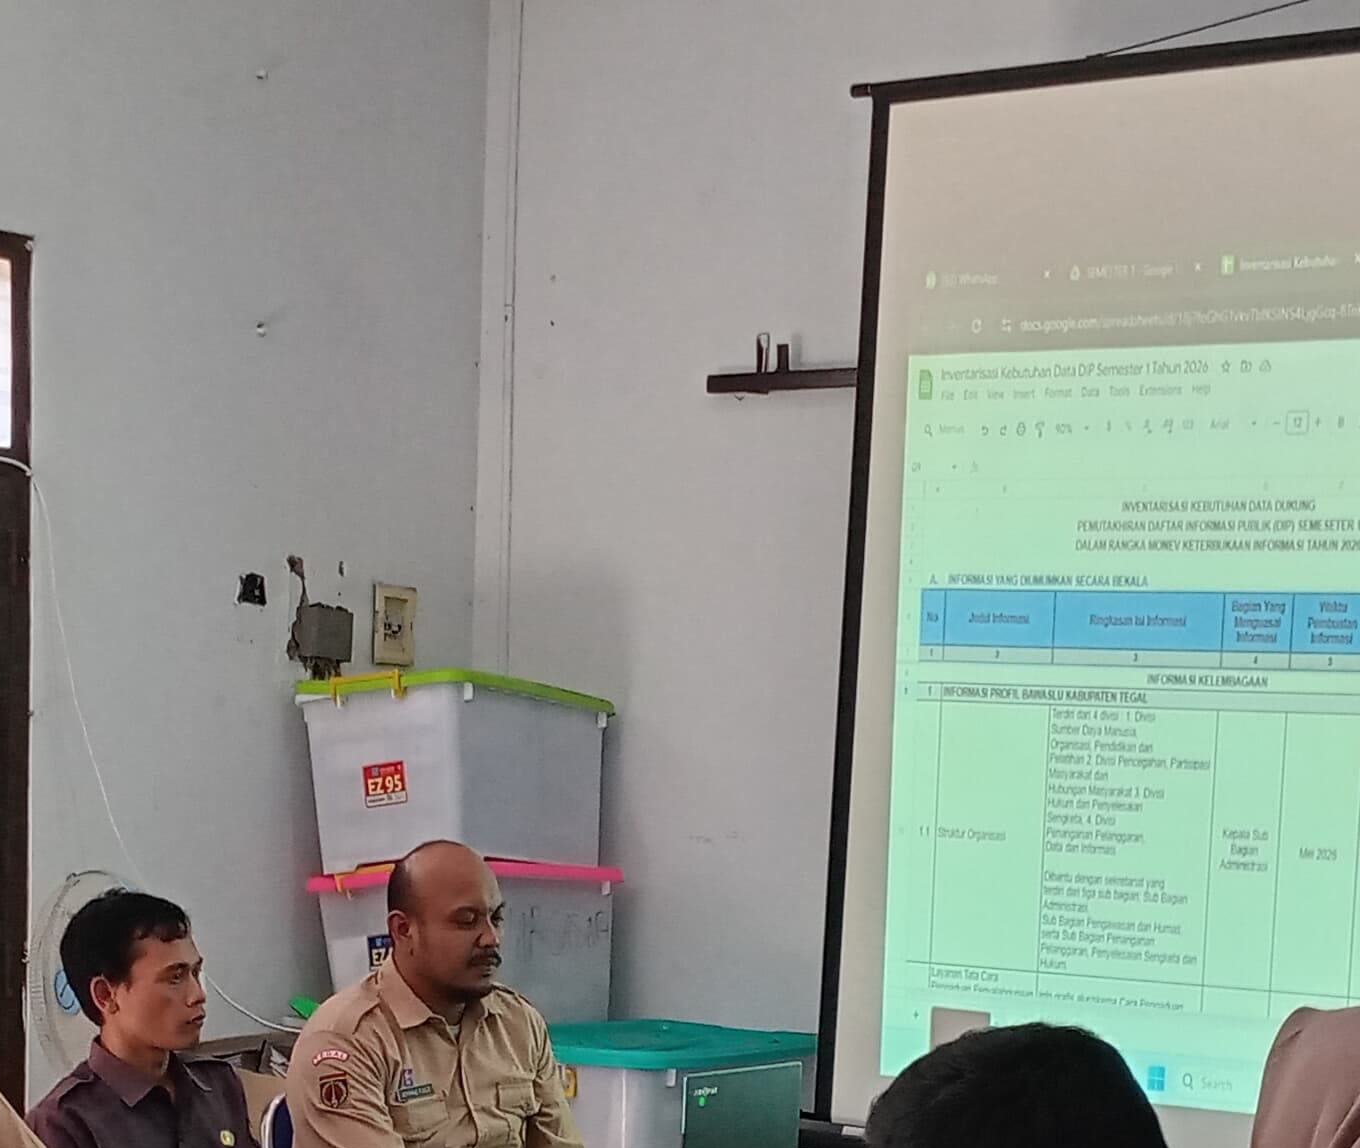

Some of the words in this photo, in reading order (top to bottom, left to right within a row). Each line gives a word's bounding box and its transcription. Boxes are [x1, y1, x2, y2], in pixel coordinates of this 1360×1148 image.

[941, 368, 998, 381] Inventarisasi
[1000, 366, 1051, 380] Kebutuhan
[1054, 364, 1076, 378] Data
[1097, 362, 1143, 376] Semester
[1152, 361, 1181, 375] Tahun
[1184, 360, 1209, 374] 2026
[1122, 500, 1188, 512] INVENTARISASI
[1190, 500, 1247, 512] KEBUTUHAN
[1249, 500, 1272, 512] DATA
[1275, 500, 1316, 512] DUKUNG
[1077, 520, 1146, 532] PEMUTAKHIRAN
[1148, 520, 1183, 532] DAFTAR
[1185, 520, 1236, 532] INFORMASI
[1238, 520, 1271, 532] PUBLIK
[1075, 539, 1107, 551] DALAM
[1109, 540, 1145, 551] RANGKA
[1148, 540, 1180, 551] MONEV
[1182, 540, 1251, 551] KETERBUKAAN
[1253, 540, 1304, 551] INFORMASI
[1307, 540, 1338, 551] TAHUN
[948, 574, 994, 585] INFORMASI
[995, 574, 1018, 586] YANG
[1075, 575, 1110, 587] SECARA
[1232, 600, 1261, 613] Bagian
[1263, 601, 1286, 615] Yang
[992, 613, 1030, 625] Informasi
[1089, 614, 1133, 628] Ringkasan
[1146, 615, 1187, 627] Informasi
[1307, 616, 1358, 629] Pembuatan
[1236, 632, 1277, 644] Informasi
[1310, 632, 1353, 644] Informasi
[1147, 674, 1196, 685] INFORMASI
[1199, 675, 1268, 687] KELEMBAGAAN
[943, 687, 987, 698] INFORMASI
[990, 688, 1018, 698] PROFIL
[1022, 688, 1063, 700] BAWASLU
[1065, 690, 1117, 702] KABUPATEN
[1120, 691, 1148, 704] TEGAL
[1051, 723, 1080, 735] Sumber
[1082, 724, 1101, 737] Daya
[1094, 740, 1137, 752] Pendidikan
[1049, 767, 1091, 780] Masyarakat
[368, 777, 385, 795] EZ
[385, 774, 402, 793] 95
[1048, 783, 1087, 797] Hubungan
[1088, 785, 1133, 798] Masyarakat
[937, 826, 966, 839] Struktur
[967, 828, 1007, 843] Organisasi
[1046, 827, 1093, 841] Penanganan
[1223, 829, 1251, 841] Kepala
[1252, 829, 1269, 841] Sub
[1231, 843, 1259, 857] Bagian
[1220, 858, 1268, 872] Administrasi
[1075, 872, 1102, 886] dengan
[1146, 879, 1166, 891] yang
[1143, 890, 1159, 903] Sub
[1160, 892, 1188, 906] Bagian
[1058, 915, 1085, 929] Bagian
[1079, 931, 1105, 944] Bagian
[1107, 932, 1155, 947] Penanganan
[1201, 1076, 1233, 1092] Search
